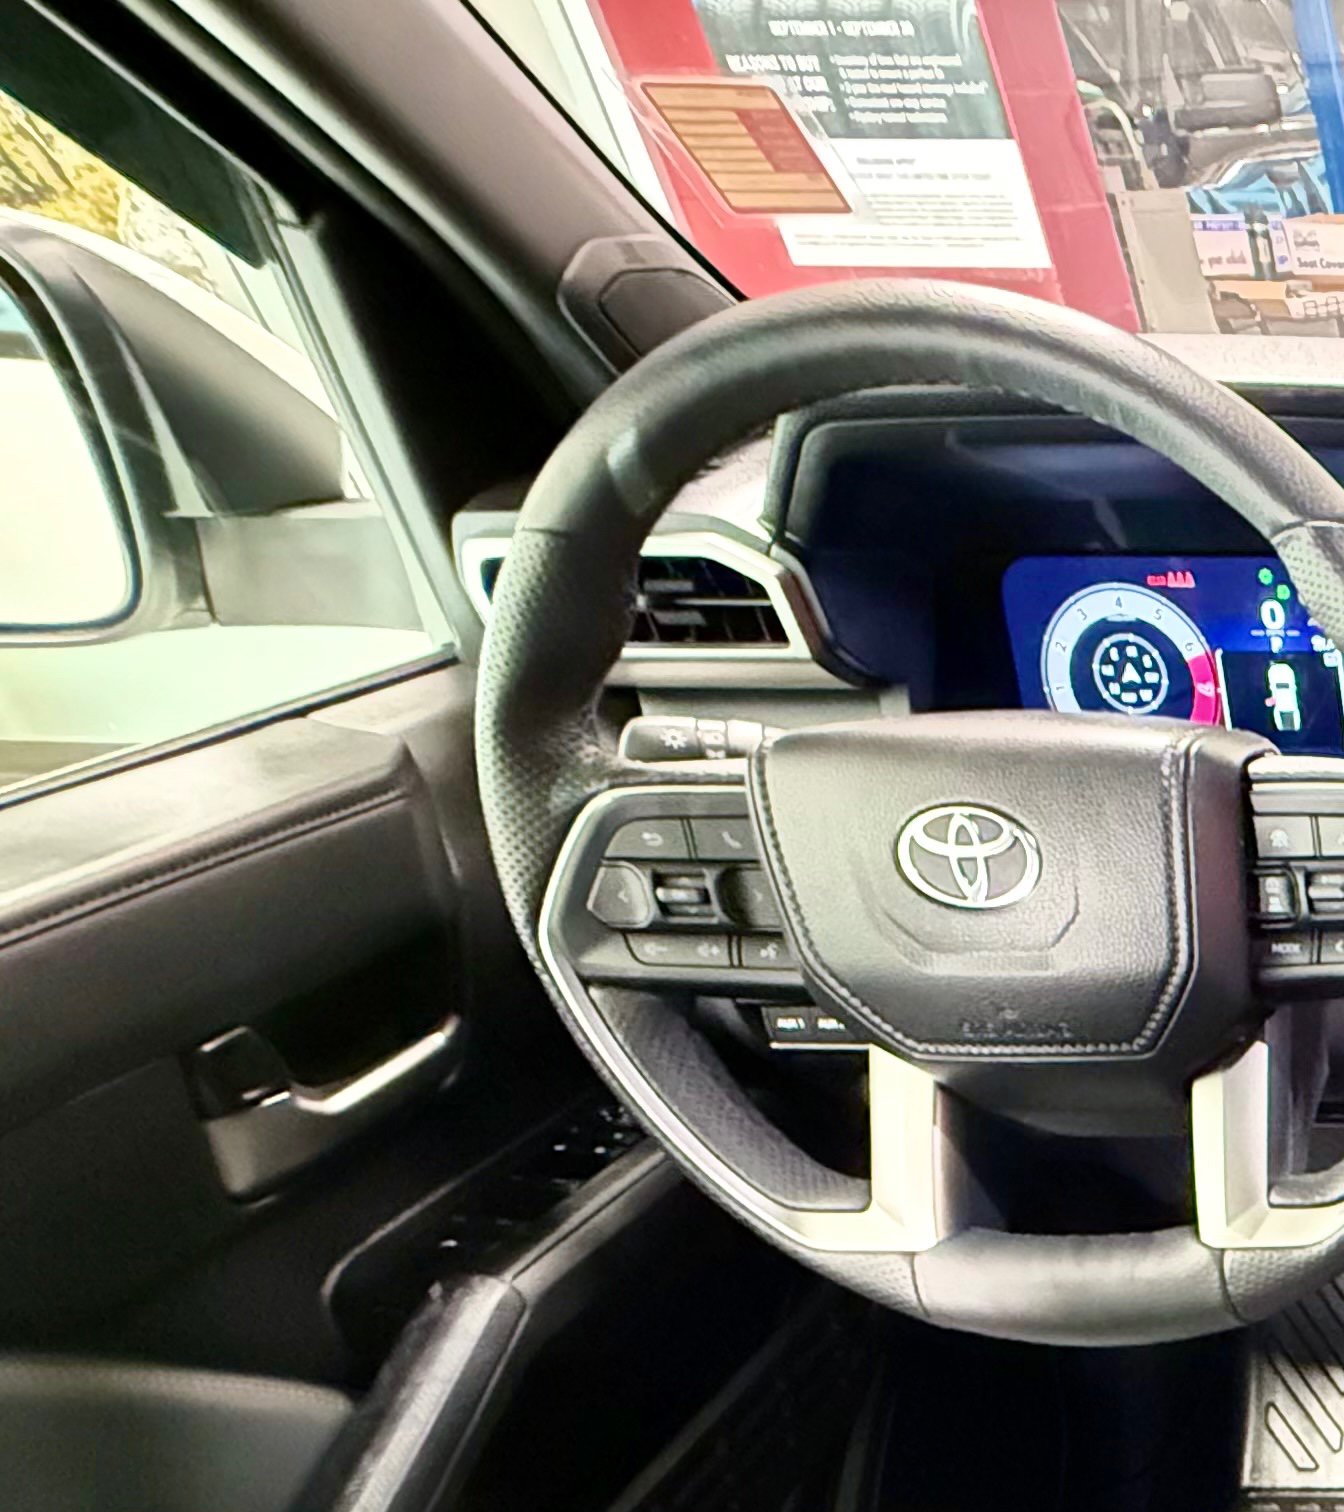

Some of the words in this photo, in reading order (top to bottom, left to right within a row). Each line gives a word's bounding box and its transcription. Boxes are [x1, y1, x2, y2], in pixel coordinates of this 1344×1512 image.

[1114, 596, 1124, 609] 4
[1076, 608, 1088, 621] 3
[1154, 608, 1165, 621] 5
[1260, 599, 1286, 630] 0
[1055, 641, 1068, 652] 2
[1184, 641, 1194, 652] 6
